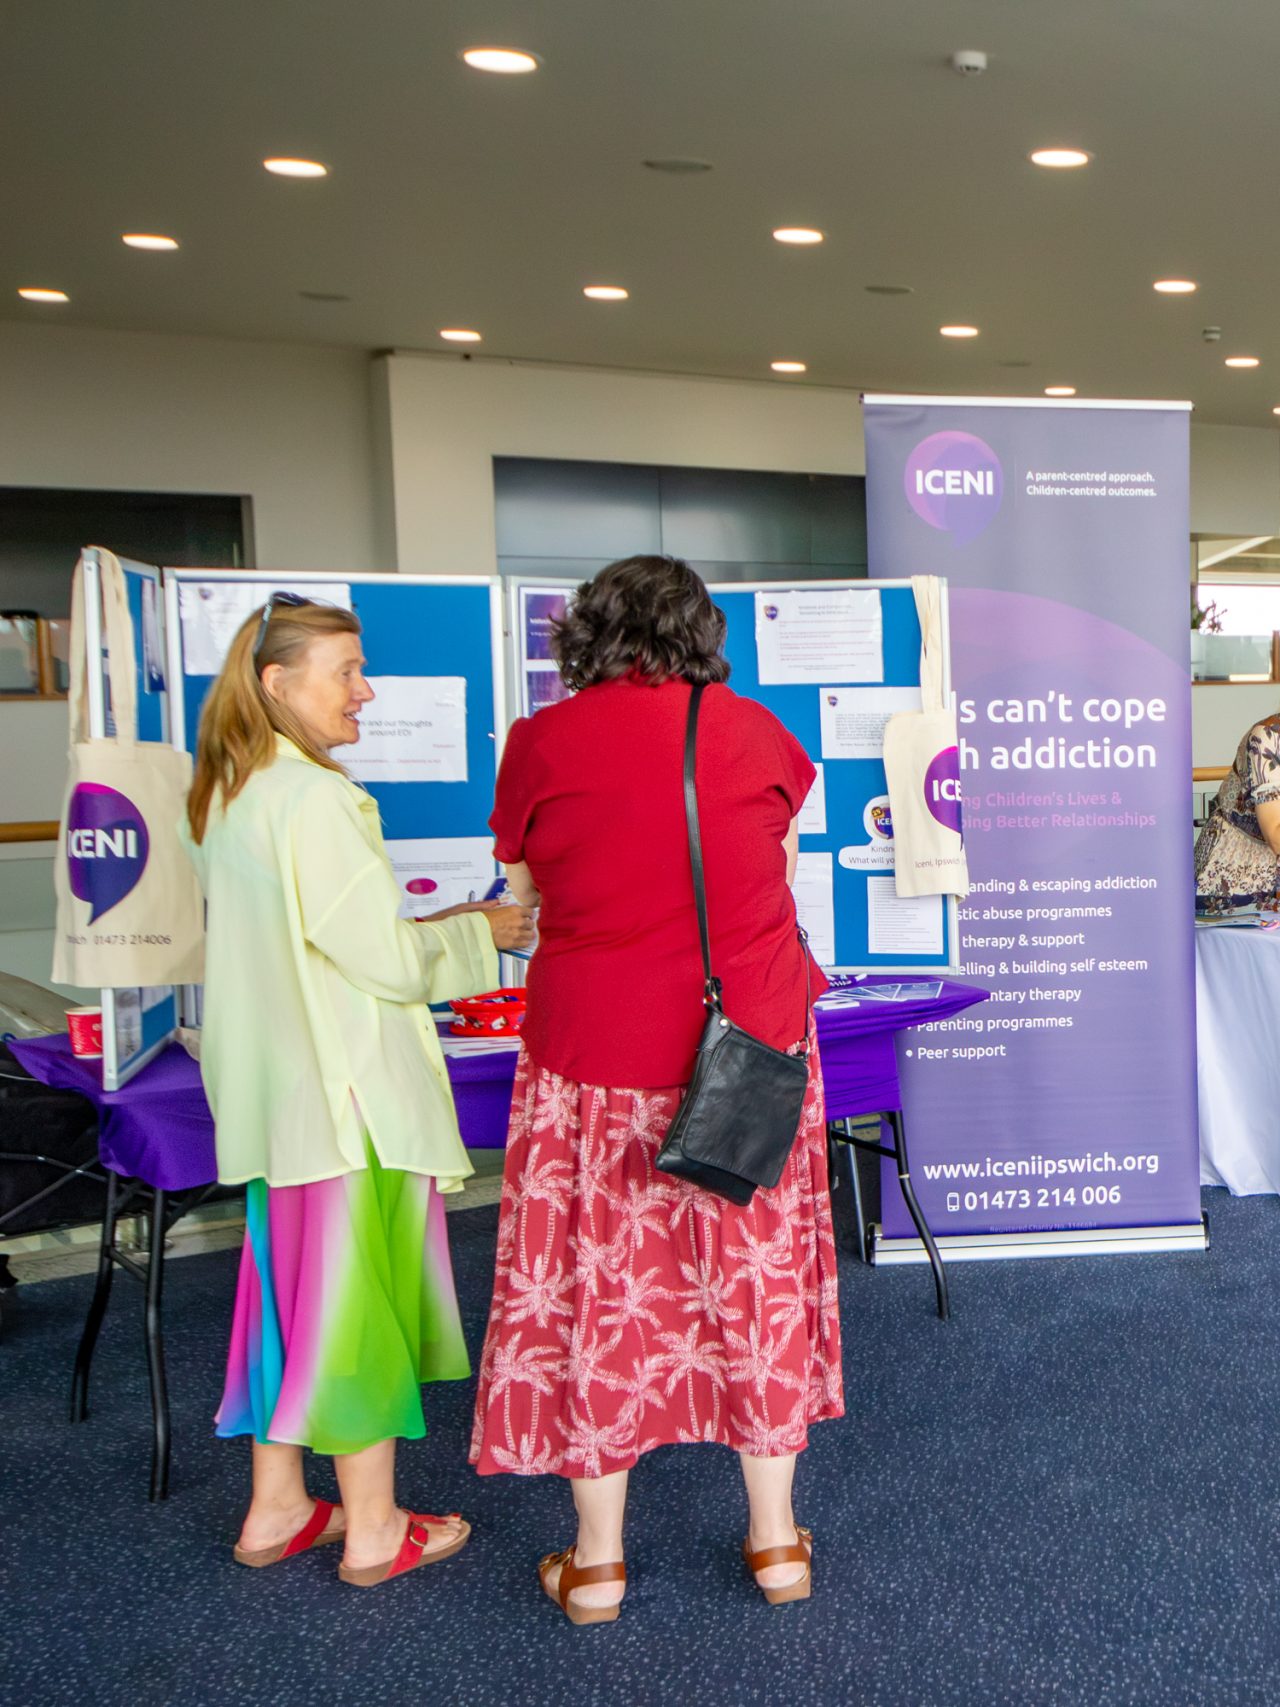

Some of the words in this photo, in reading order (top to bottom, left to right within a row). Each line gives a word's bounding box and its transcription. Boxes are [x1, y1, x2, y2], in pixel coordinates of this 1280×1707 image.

[915, 469, 994, 496] ICENI
[1026, 470, 1034, 480] A
[1035, 471, 1107, 482] parent-centred
[1108, 471, 1155, 483] approach.
[1026, 485, 1106, 496] Children-centred
[1108, 486, 1157, 496] outcomes.
[1082, 697, 1167, 729] cope
[990, 736, 1156, 770] addiction
[1068, 791, 1107, 806] Lives
[1111, 791, 1122, 805] &
[996, 814, 1048, 829] Better
[1051, 811, 1156, 828] Relationships
[870, 856, 884, 864] will
[968, 879, 1015, 894] anding
[1019, 879, 1029, 891] &
[1032, 877, 1091, 893] escaping
[1094, 876, 1157, 890] addiction
[956, 907, 980, 921] stic
[982, 906, 1023, 920] abuse
[1026, 906, 1113, 921] programmes
[962, 934, 1015, 949] therapy
[1018, 934, 1029, 946] &
[1031, 932, 1085, 948] support
[959, 962, 996, 976] elling
[999, 963, 1009, 975] &
[1012, 960, 1067, 975] building
[1070, 958, 1096, 972] self
[1098, 959, 1148, 971] esteem
[988, 988, 1026, 1003] ntary
[1029, 987, 1082, 1002] therapy
[917, 1016, 984, 1034] Parenting
[987, 1015, 1073, 1032] programmes
[917, 1046, 949, 1059] Peer
[952, 1044, 1006, 1060] support
[923, 1151, 1159, 1180] www.iceniipswich.org
[964, 1189, 1031, 1211] 01473
[1036, 1187, 1077, 1208] 214
[1081, 1185, 1122, 1206] 006
